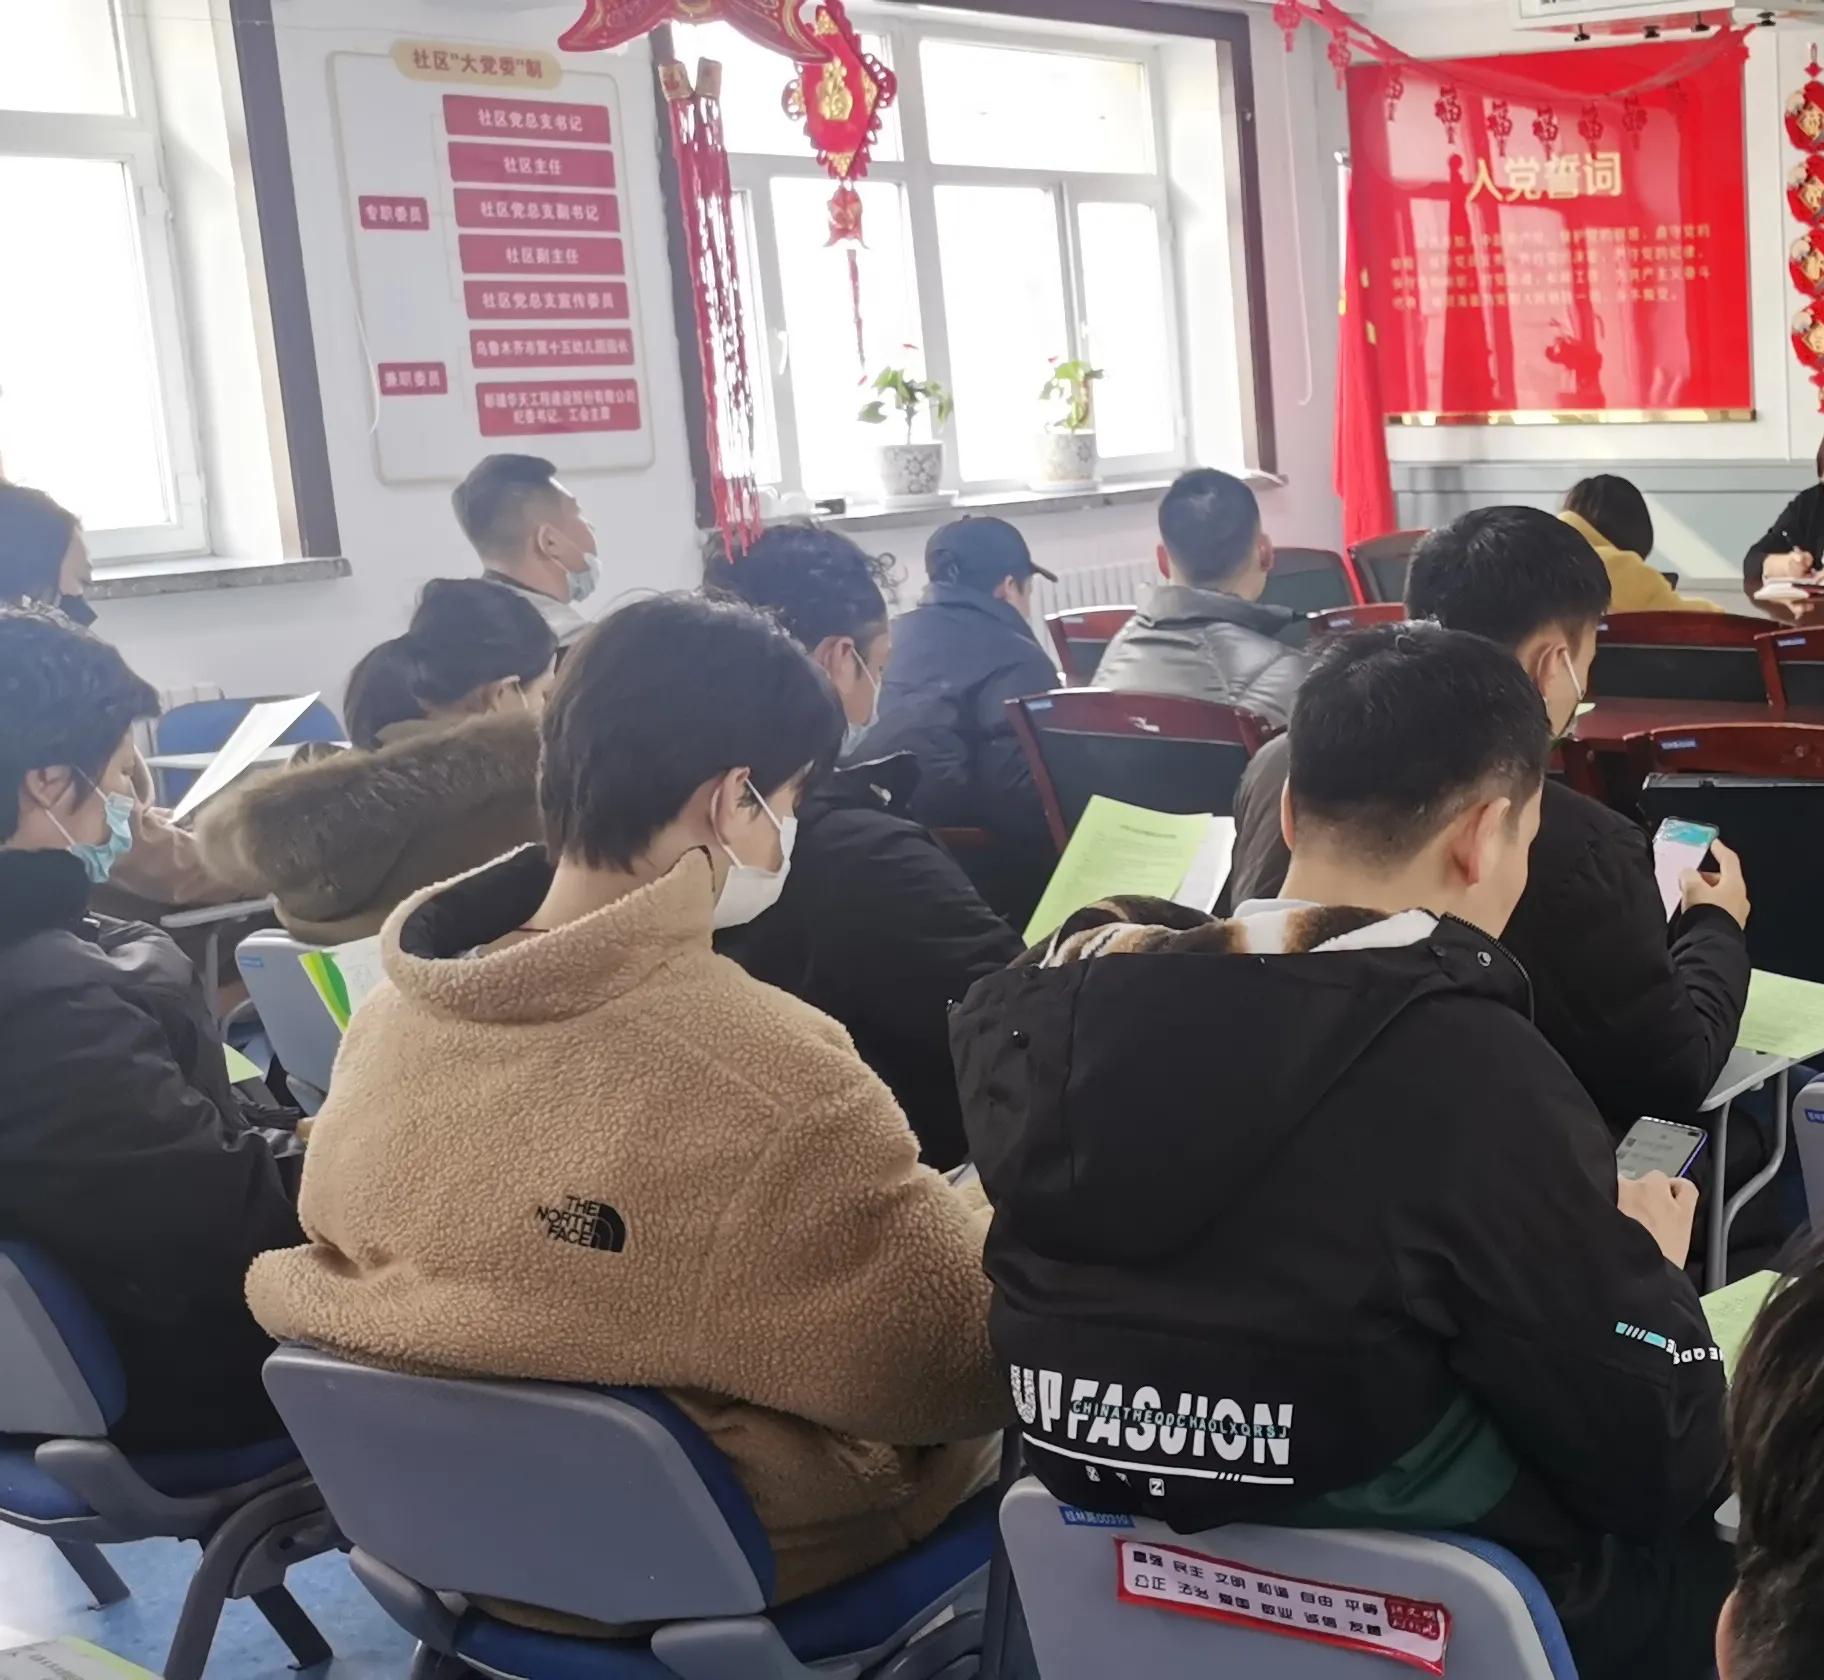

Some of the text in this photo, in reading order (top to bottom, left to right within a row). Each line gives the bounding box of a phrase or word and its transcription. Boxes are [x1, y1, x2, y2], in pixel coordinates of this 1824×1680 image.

[477, 108, 583, 132] 社区党总支书记
[503, 157, 562, 175] 社区主任
[480, 201, 599, 221] 社区党总支副书记
[505, 247, 579, 264] 社区副主任
[566, 1194, 600, 1216] THE
[534, 1205, 596, 1232] NORTH
[547, 1222, 592, 1247] FACE
[1173, 1560, 1204, 1579] 民主
[1215, 1572, 1246, 1589] 文明
[1257, 1581, 1289, 1598] 和谐
[1301, 1591, 1333, 1607] 自由
[1135, 1574, 1166, 1591] 公正
[1178, 1581, 1209, 1599] 法治
[1261, 1602, 1293, 1619] 敬业
[1304, 1612, 1337, 1628] 诚信
